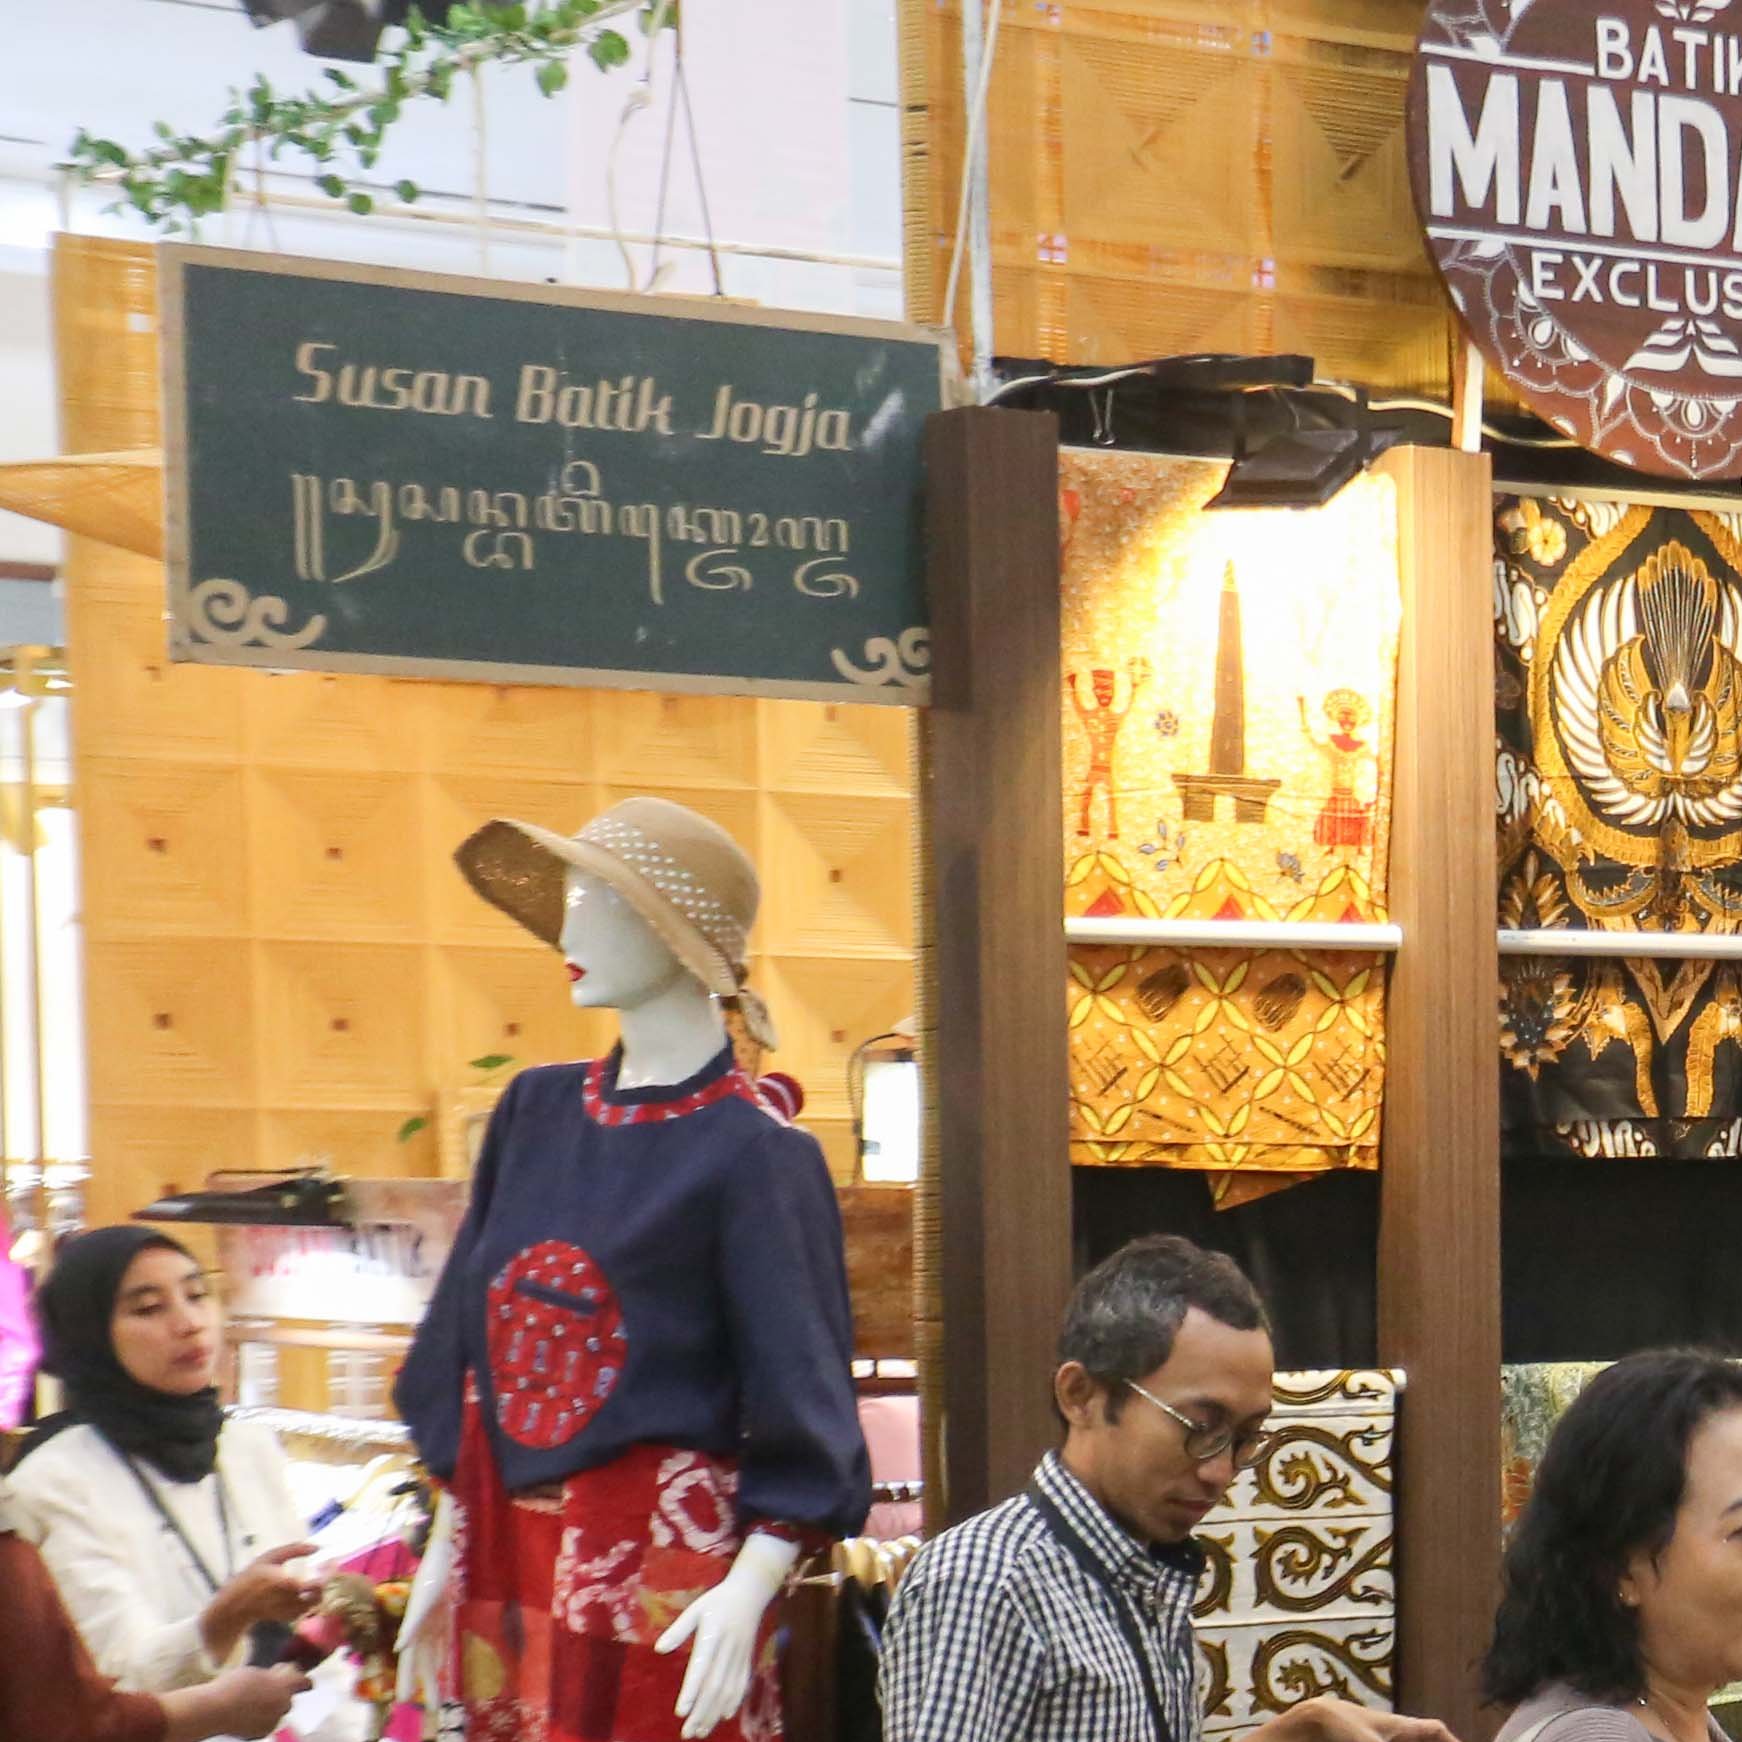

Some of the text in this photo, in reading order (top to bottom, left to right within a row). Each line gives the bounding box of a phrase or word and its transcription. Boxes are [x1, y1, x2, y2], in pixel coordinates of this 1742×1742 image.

[292, 340, 853, 457] Susan Batik Jogja
